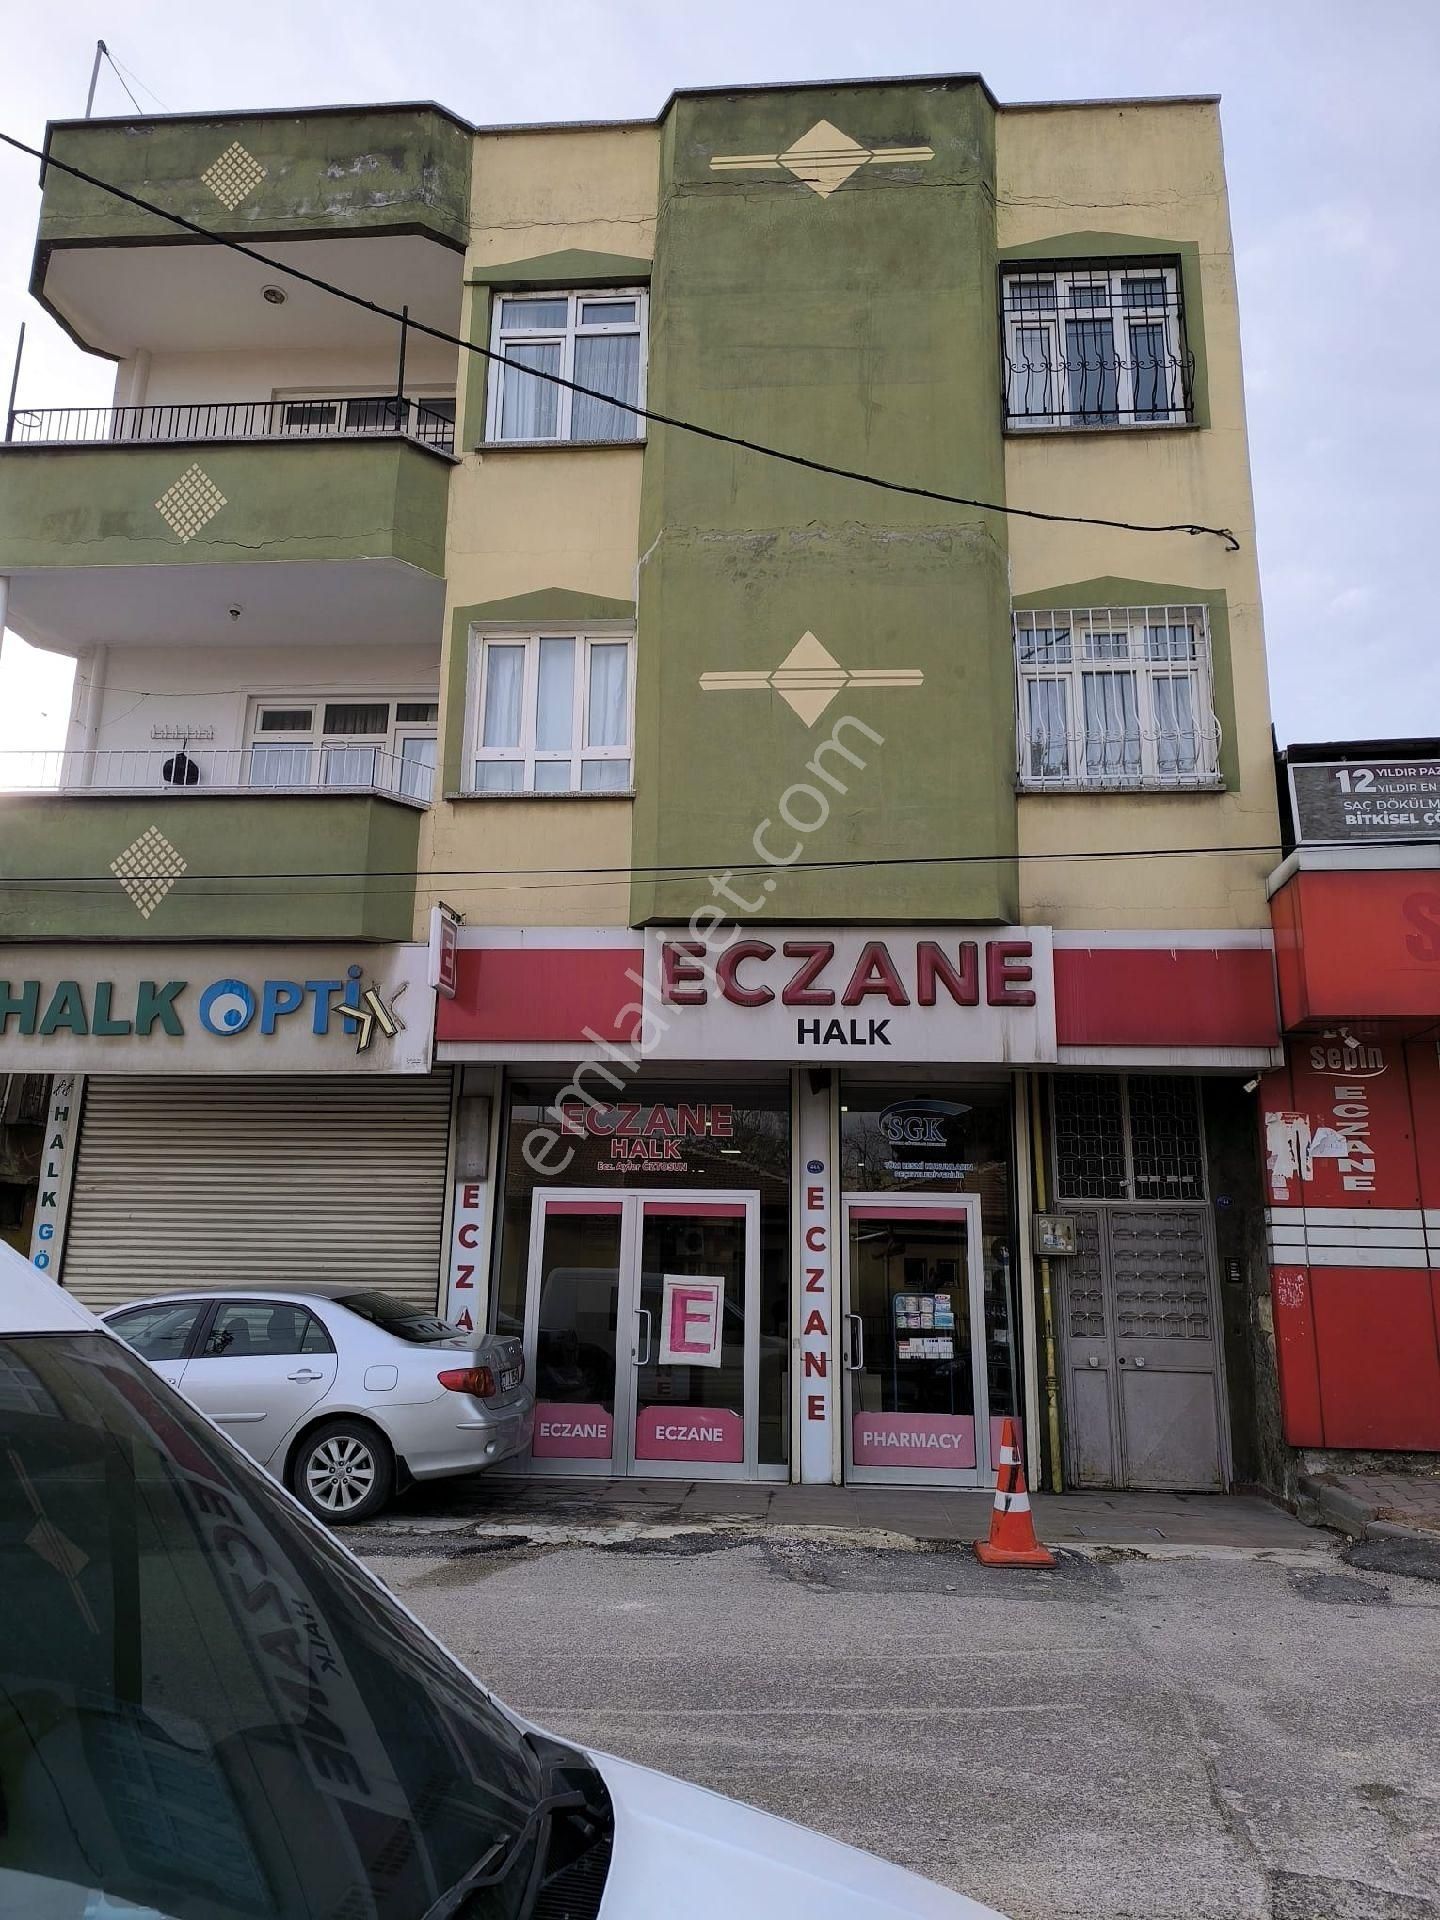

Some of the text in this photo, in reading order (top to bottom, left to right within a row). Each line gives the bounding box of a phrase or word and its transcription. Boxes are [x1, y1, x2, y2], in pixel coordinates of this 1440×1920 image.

[1335, 768, 1377, 793] 12
[1376, 768, 1417, 777] YILDIR
[1377, 783, 1437, 793] YILDIR EN
[1344, 801, 1372, 812] SAÇ
[1345, 811, 1420, 825] BİTKİSEL
[662, 939, 1037, 1007] ECZANE
[0, 980, 188, 1036] HALK
[797, 1018, 892, 1046] HALK
[561, 1102, 734, 1136] ECZANE
[888, 1116, 948, 1143] SGK
[610, 1138, 682, 1159] HALK
[1333, 1086, 1376, 1191] ECZANE
[41, 1107, 68, 1208] HALK
[804, 1187, 828, 1420] ECZANE
[670, 1288, 713, 1353] E
[540, 1423, 607, 1438] ECZANE
[656, 1425, 723, 1442] ECZANE
[863, 1431, 962, 1449] PHARMACY
